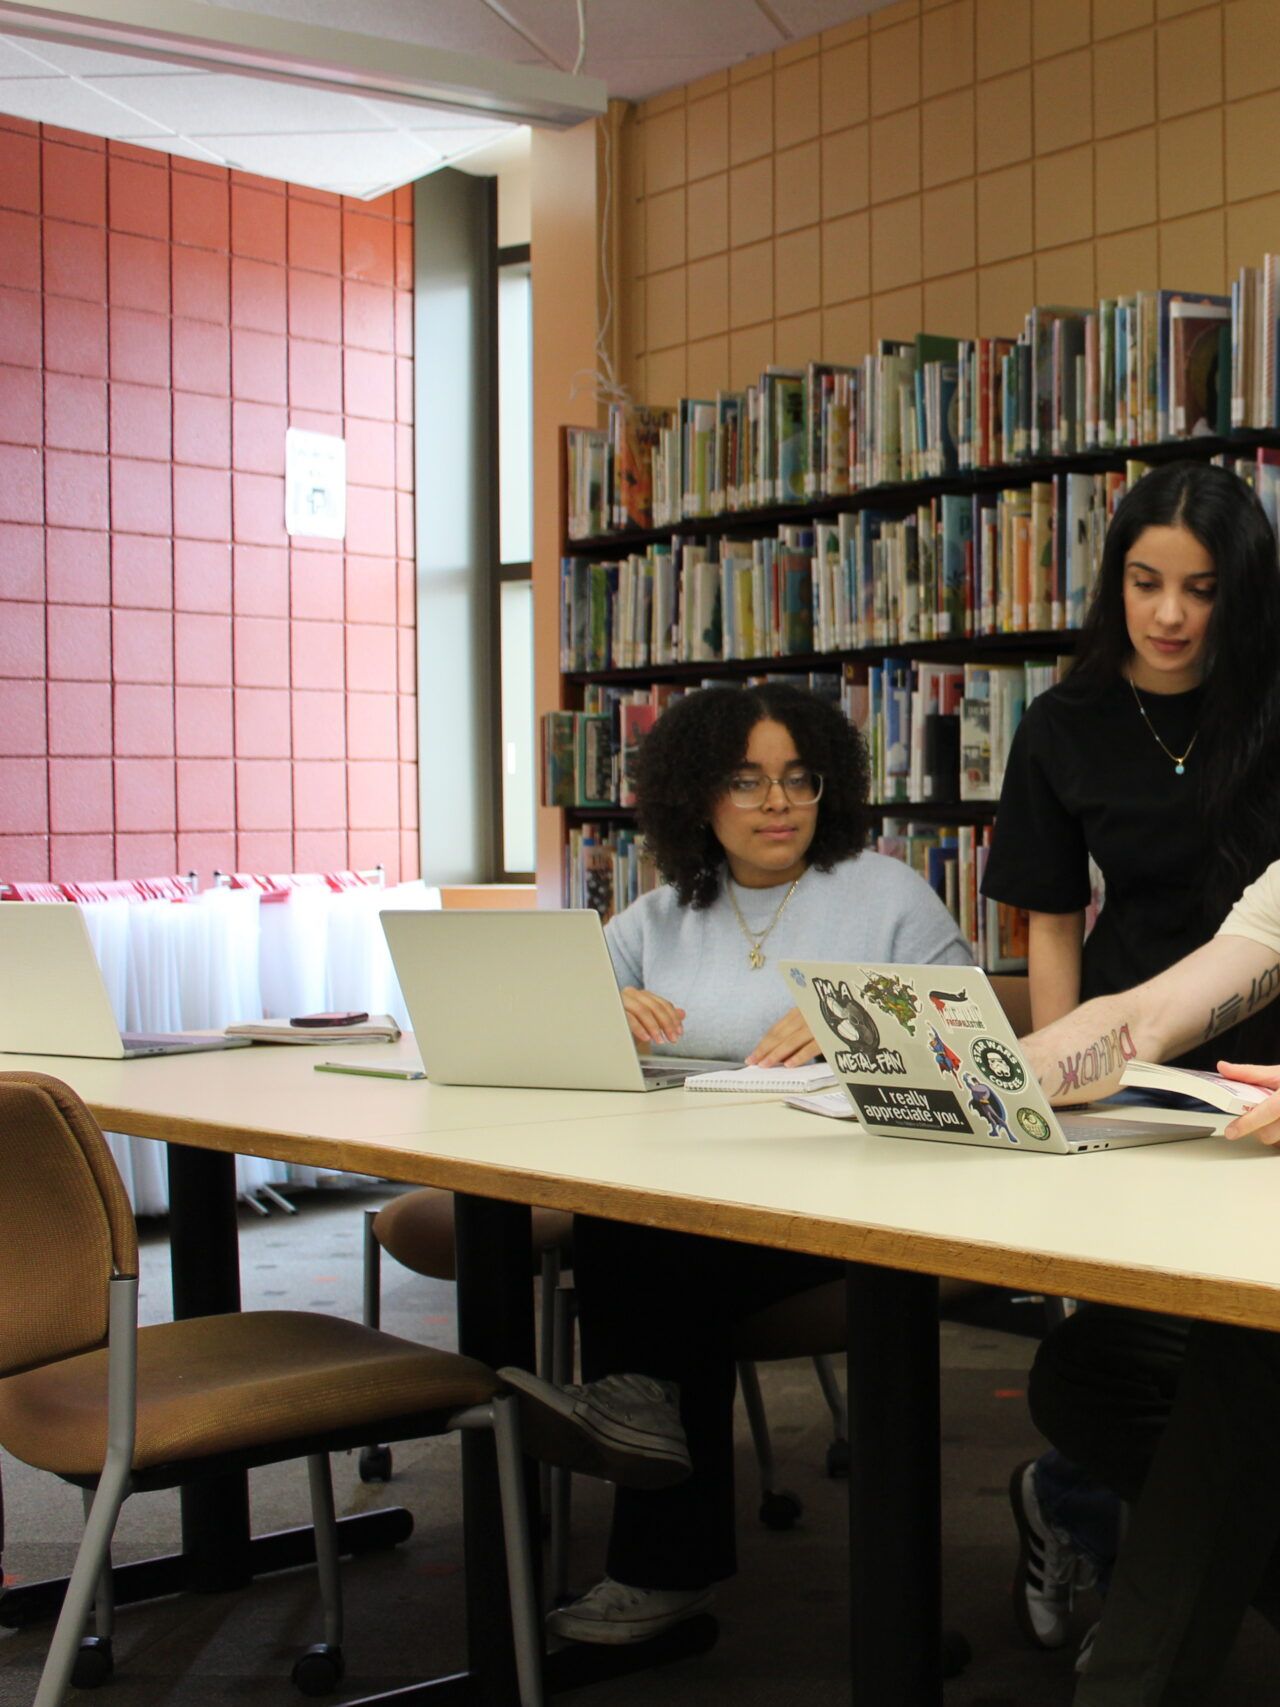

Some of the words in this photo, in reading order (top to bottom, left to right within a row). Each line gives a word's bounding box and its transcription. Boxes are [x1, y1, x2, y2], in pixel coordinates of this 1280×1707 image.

[841, 982, 853, 1001] A
[836, 1052, 877, 1073] METAL
[876, 1050, 904, 1073] FAN
[974, 1041, 987, 1063] STAR
[986, 1040, 1018, 1064] WARS
[989, 1076, 1023, 1090] COFFEE
[878, 1087, 888, 1103] I
[889, 1090, 931, 1110] really
[864, 1104, 933, 1122] appreciate
[934, 1111, 965, 1127] you.
